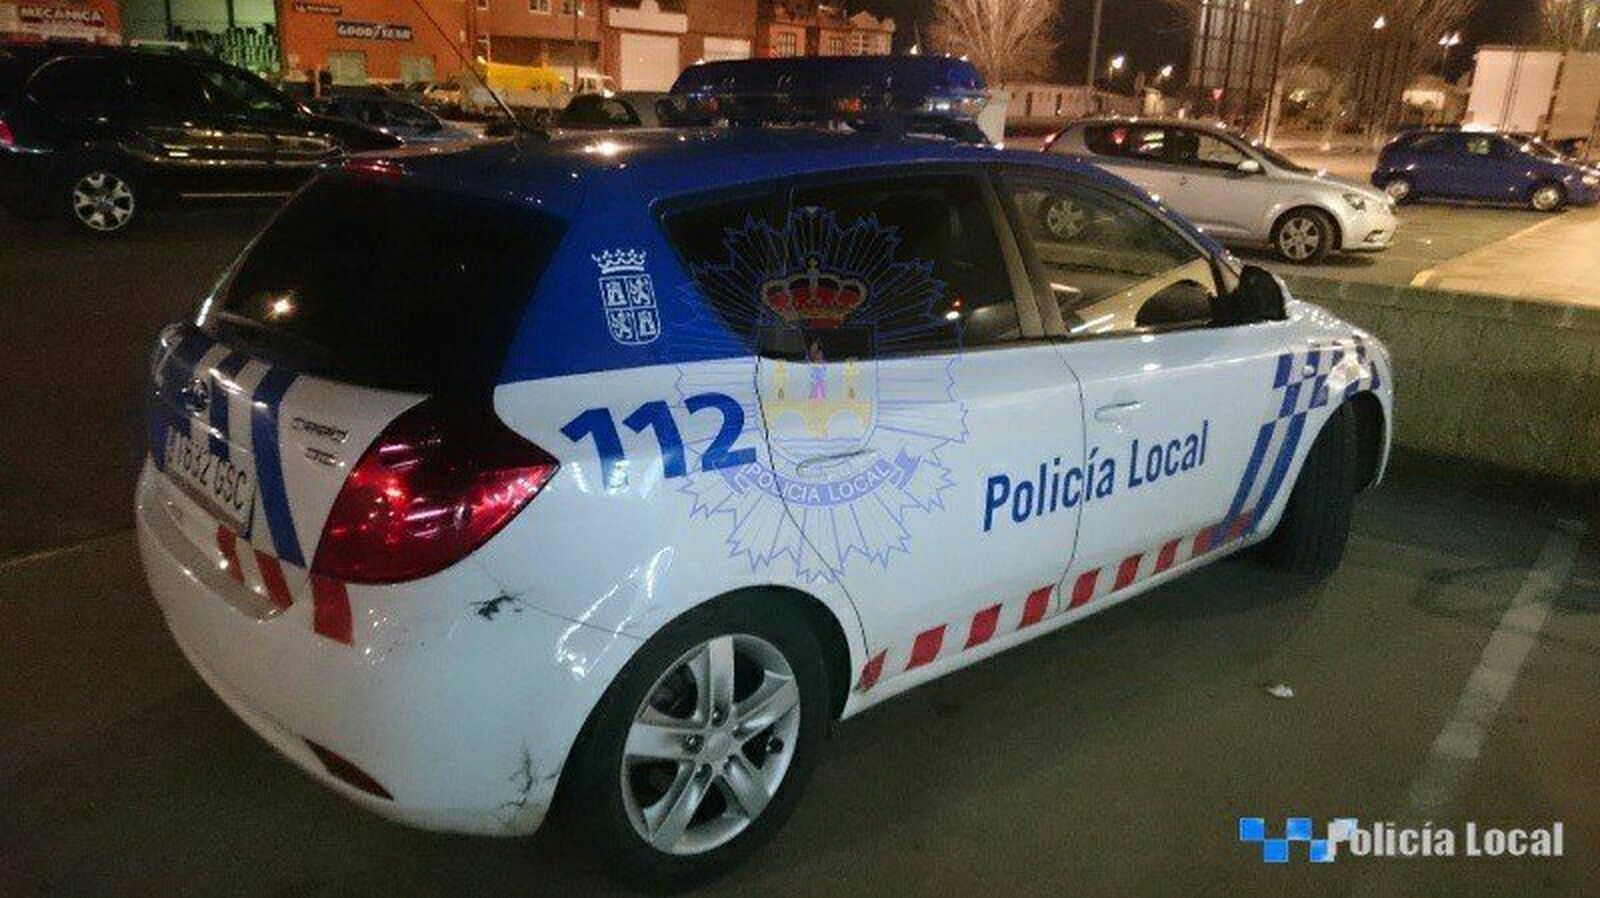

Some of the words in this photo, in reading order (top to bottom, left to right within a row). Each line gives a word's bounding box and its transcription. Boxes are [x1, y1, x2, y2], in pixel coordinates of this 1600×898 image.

[560, 391, 757, 491] 112
[984, 446, 1116, 533] Policía
[1128, 418, 1209, 489] Local
